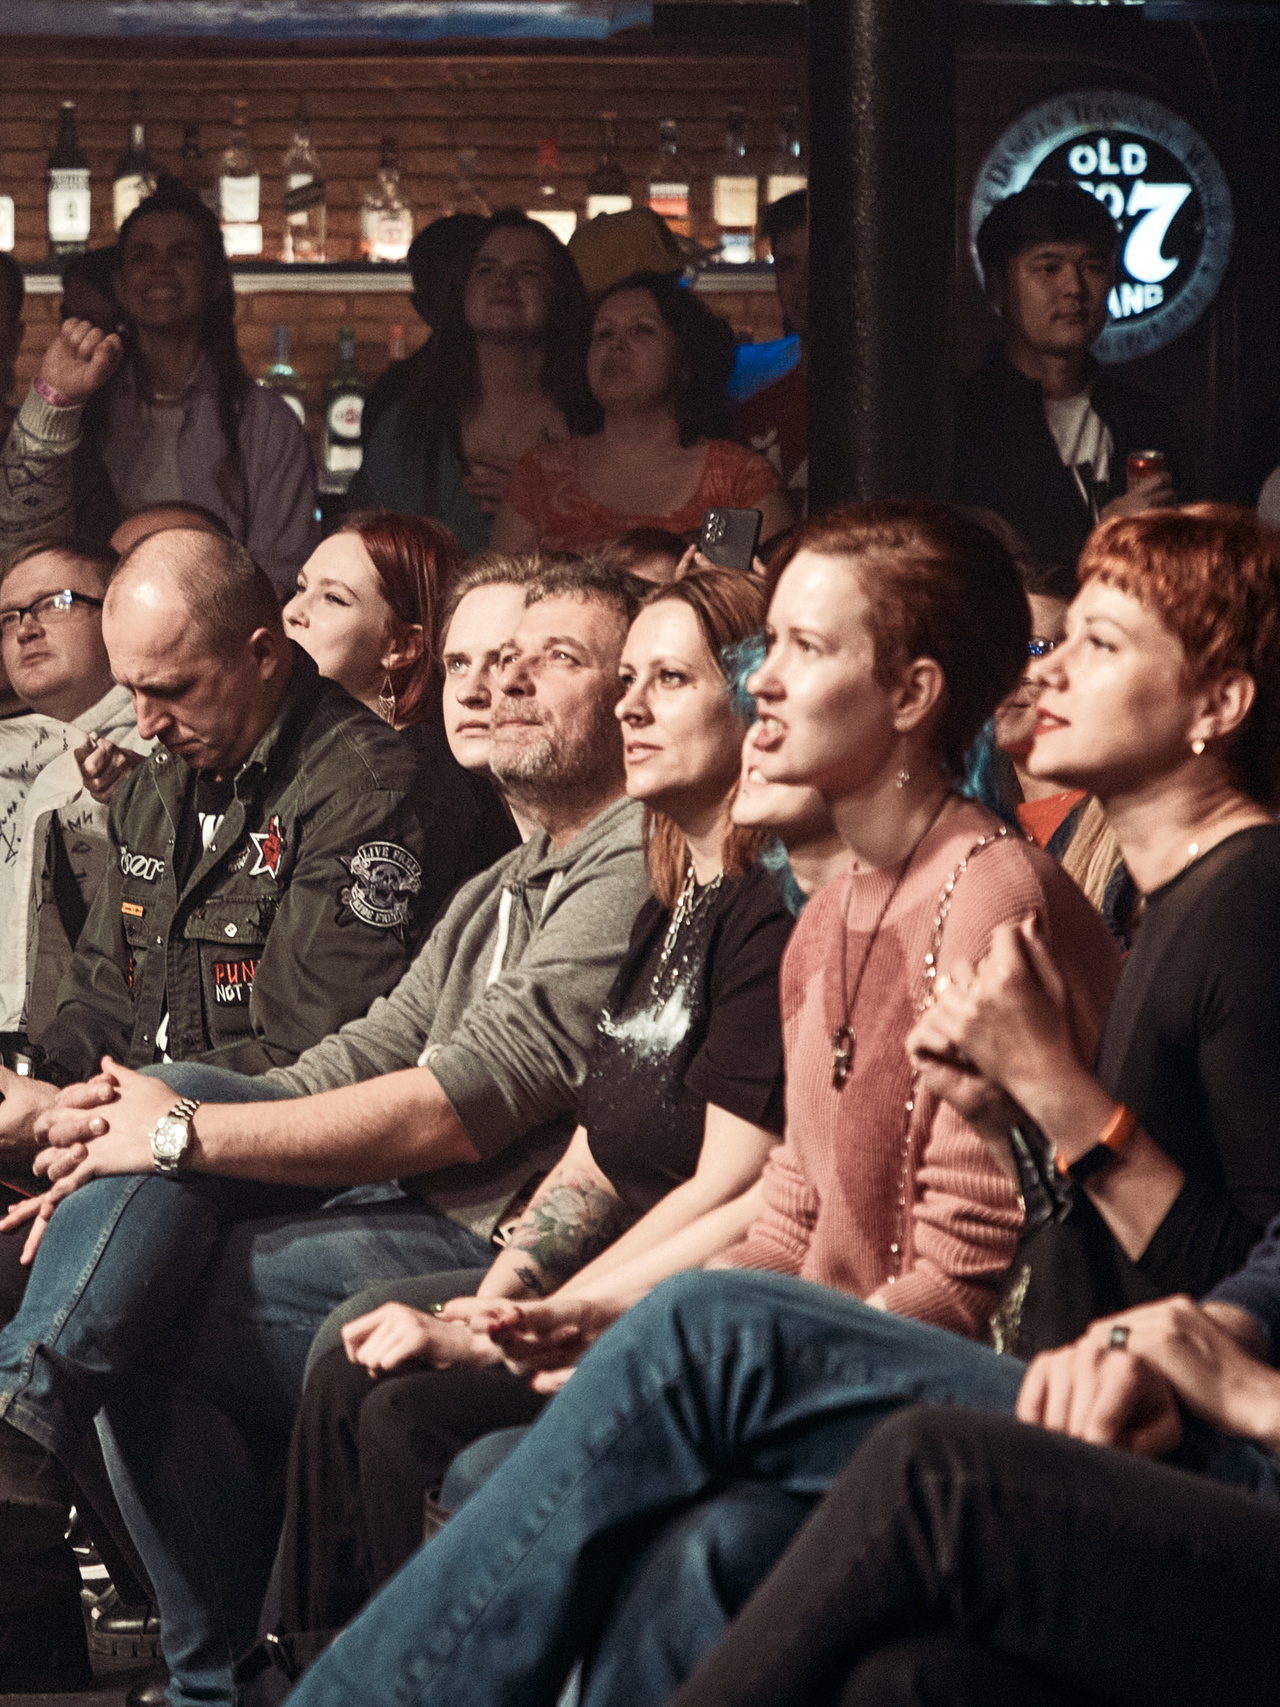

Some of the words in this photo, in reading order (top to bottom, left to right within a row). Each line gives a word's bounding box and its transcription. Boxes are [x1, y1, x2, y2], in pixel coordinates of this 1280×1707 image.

[1069, 138, 1148, 176] OLD
[1124, 178, 1193, 284] 7
[1107, 282, 1164, 319] AND
[361, 846, 389, 859] LIVE
[392, 848, 419, 877] FREE
[213, 959, 261, 984] PUN
[215, 983, 243, 1002] NOT
